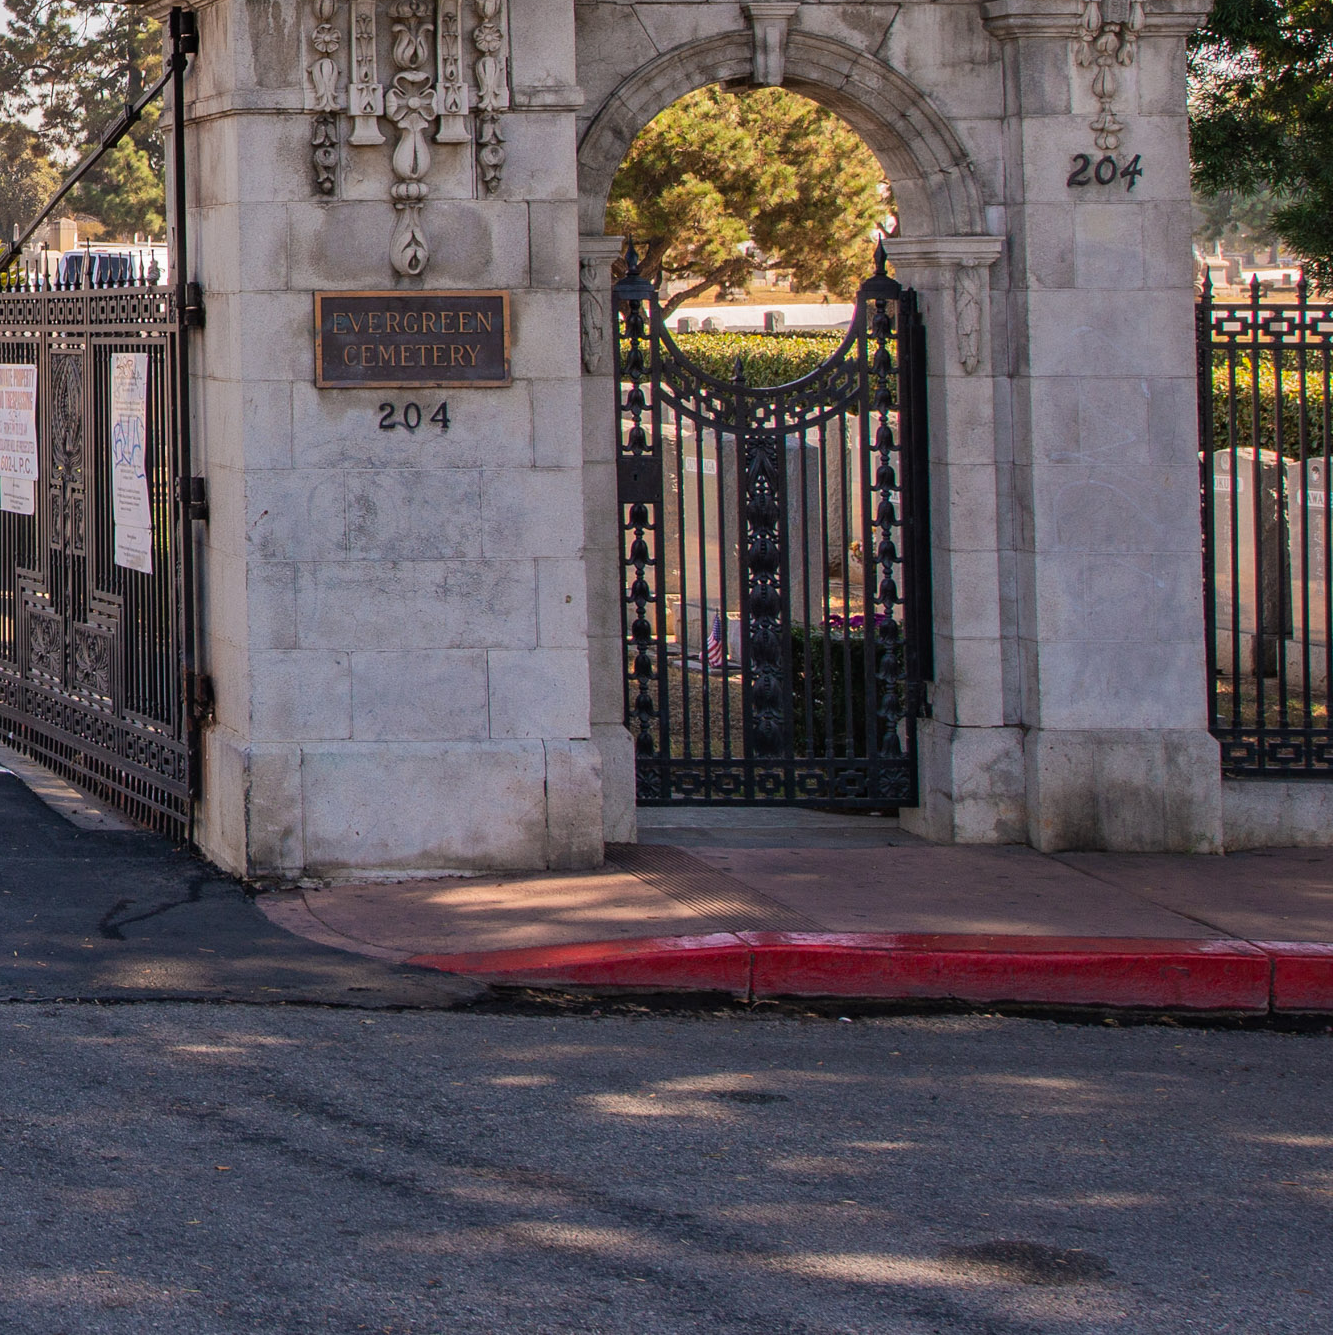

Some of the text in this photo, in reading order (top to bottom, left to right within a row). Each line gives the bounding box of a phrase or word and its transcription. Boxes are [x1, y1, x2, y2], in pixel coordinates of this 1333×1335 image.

[1067, 153, 1143, 192] 204
[333, 311, 493, 334] EVERGREEN
[344, 345, 481, 366] CEMETERY
[379, 401, 451, 429] 204
[1, 455, 33, 475] 602-L P.C.
